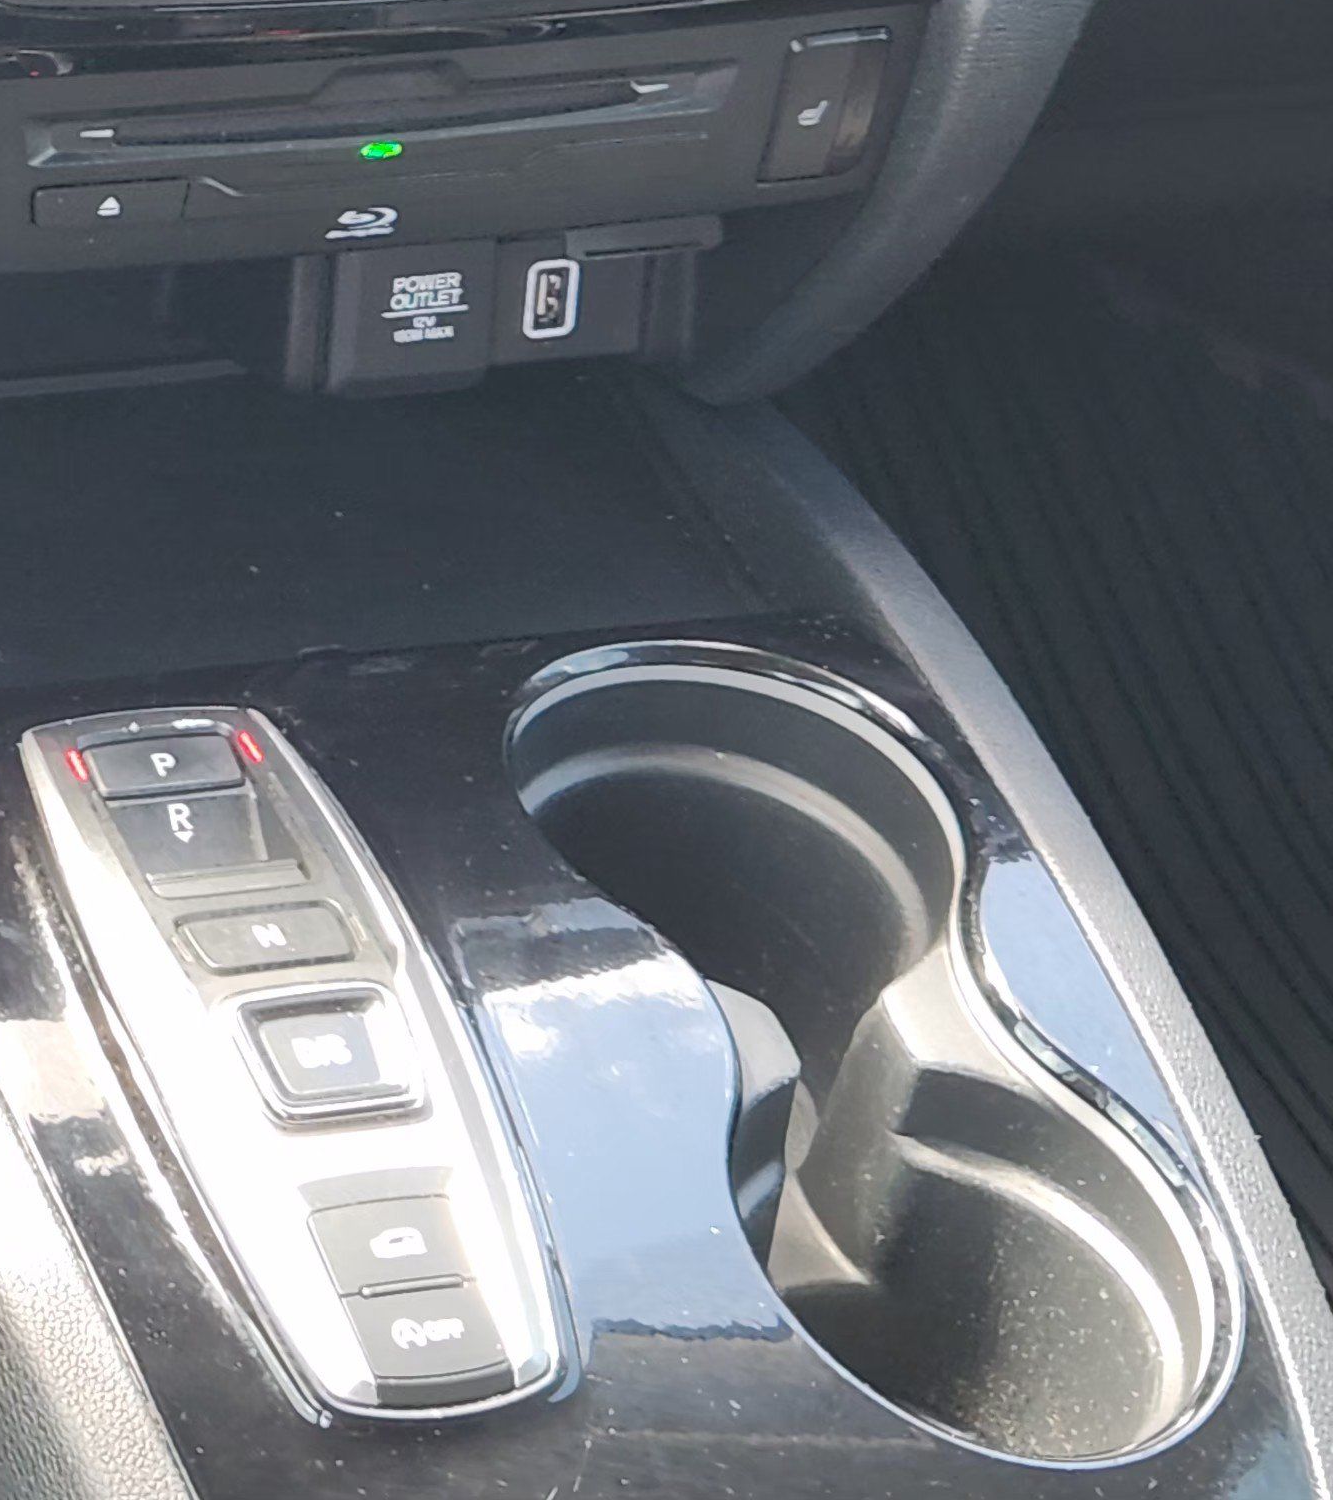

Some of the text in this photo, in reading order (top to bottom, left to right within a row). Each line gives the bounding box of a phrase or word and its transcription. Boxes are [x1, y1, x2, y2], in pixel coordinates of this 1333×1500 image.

[393, 272, 463, 293] POWER
[390, 288, 464, 311] OUTLET
[150, 752, 176, 777] P
[168, 803, 194, 831] R
[251, 923, 288, 948] N
